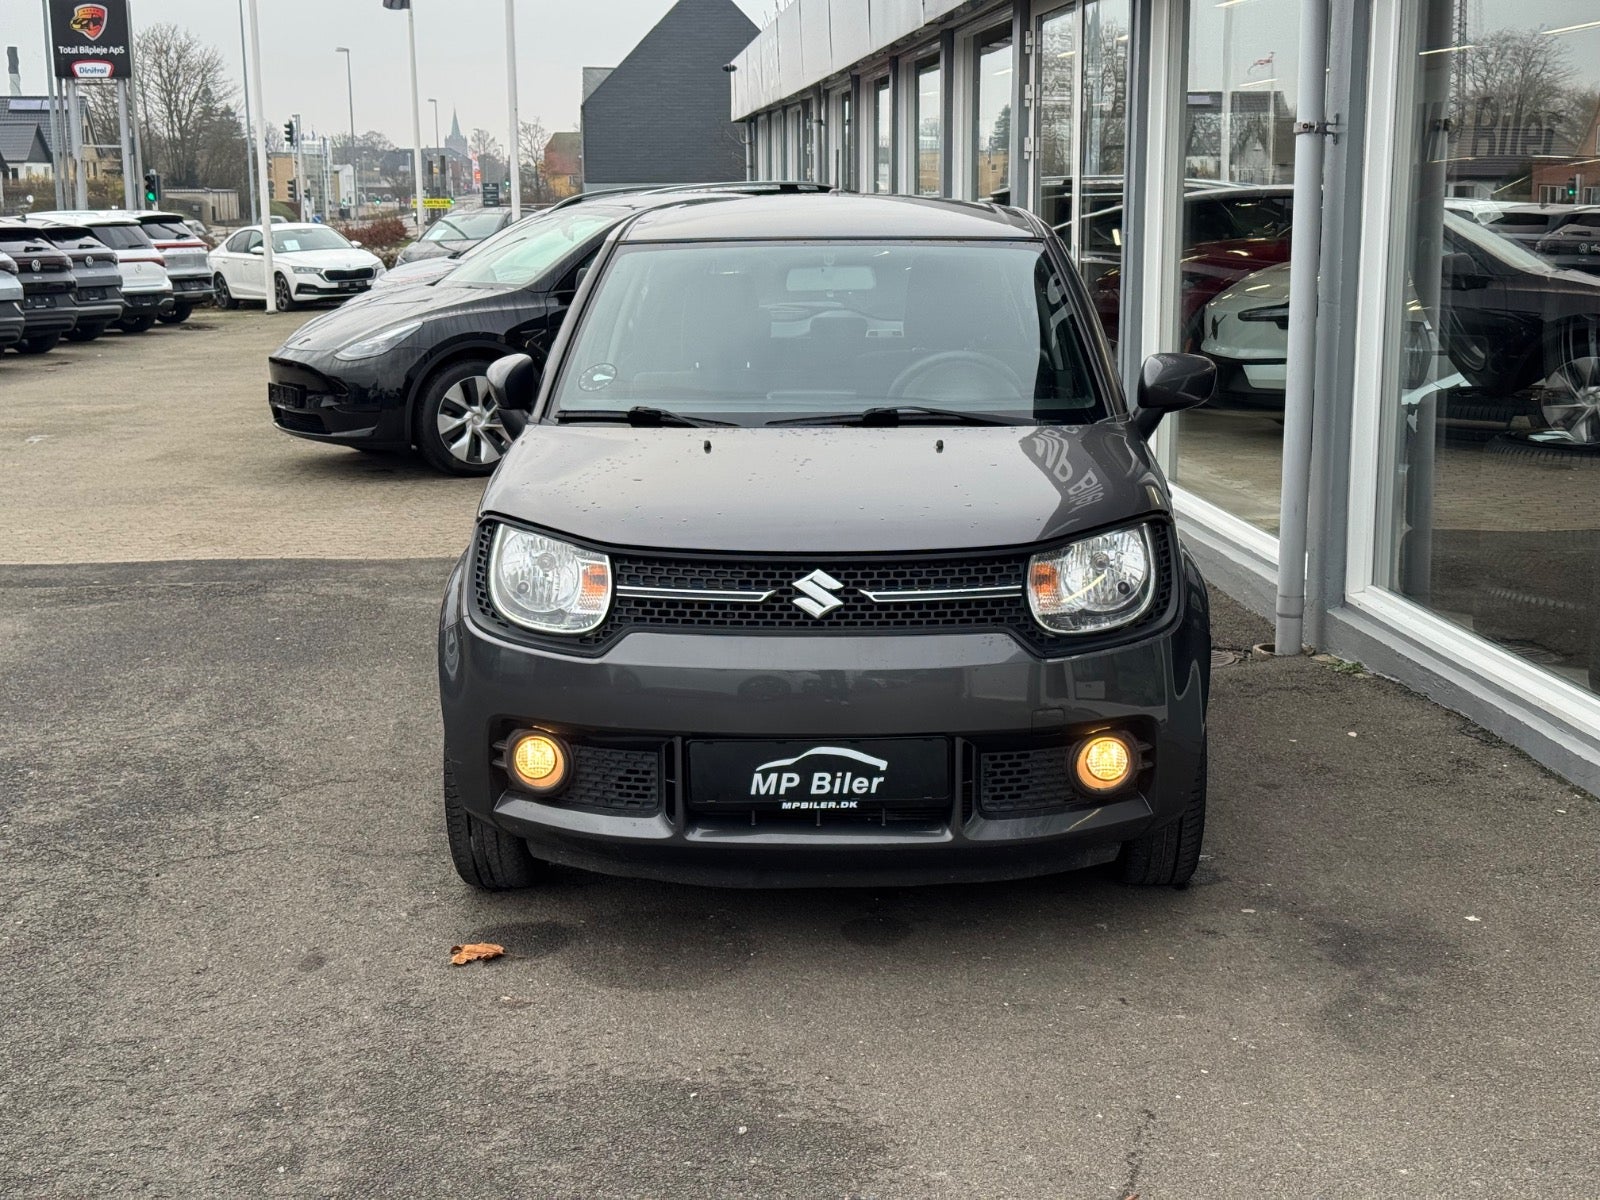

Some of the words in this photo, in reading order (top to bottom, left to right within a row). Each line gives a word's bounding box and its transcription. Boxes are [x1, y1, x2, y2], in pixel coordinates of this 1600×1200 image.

[58, 46, 78, 54] Total
[80, 46, 107, 55] Bilpleje
[109, 46, 125, 55] ApS
[750, 772, 801, 795] MP
[810, 772, 885, 795] Biler
[781, 801, 858, 809] MPBILER.DK
